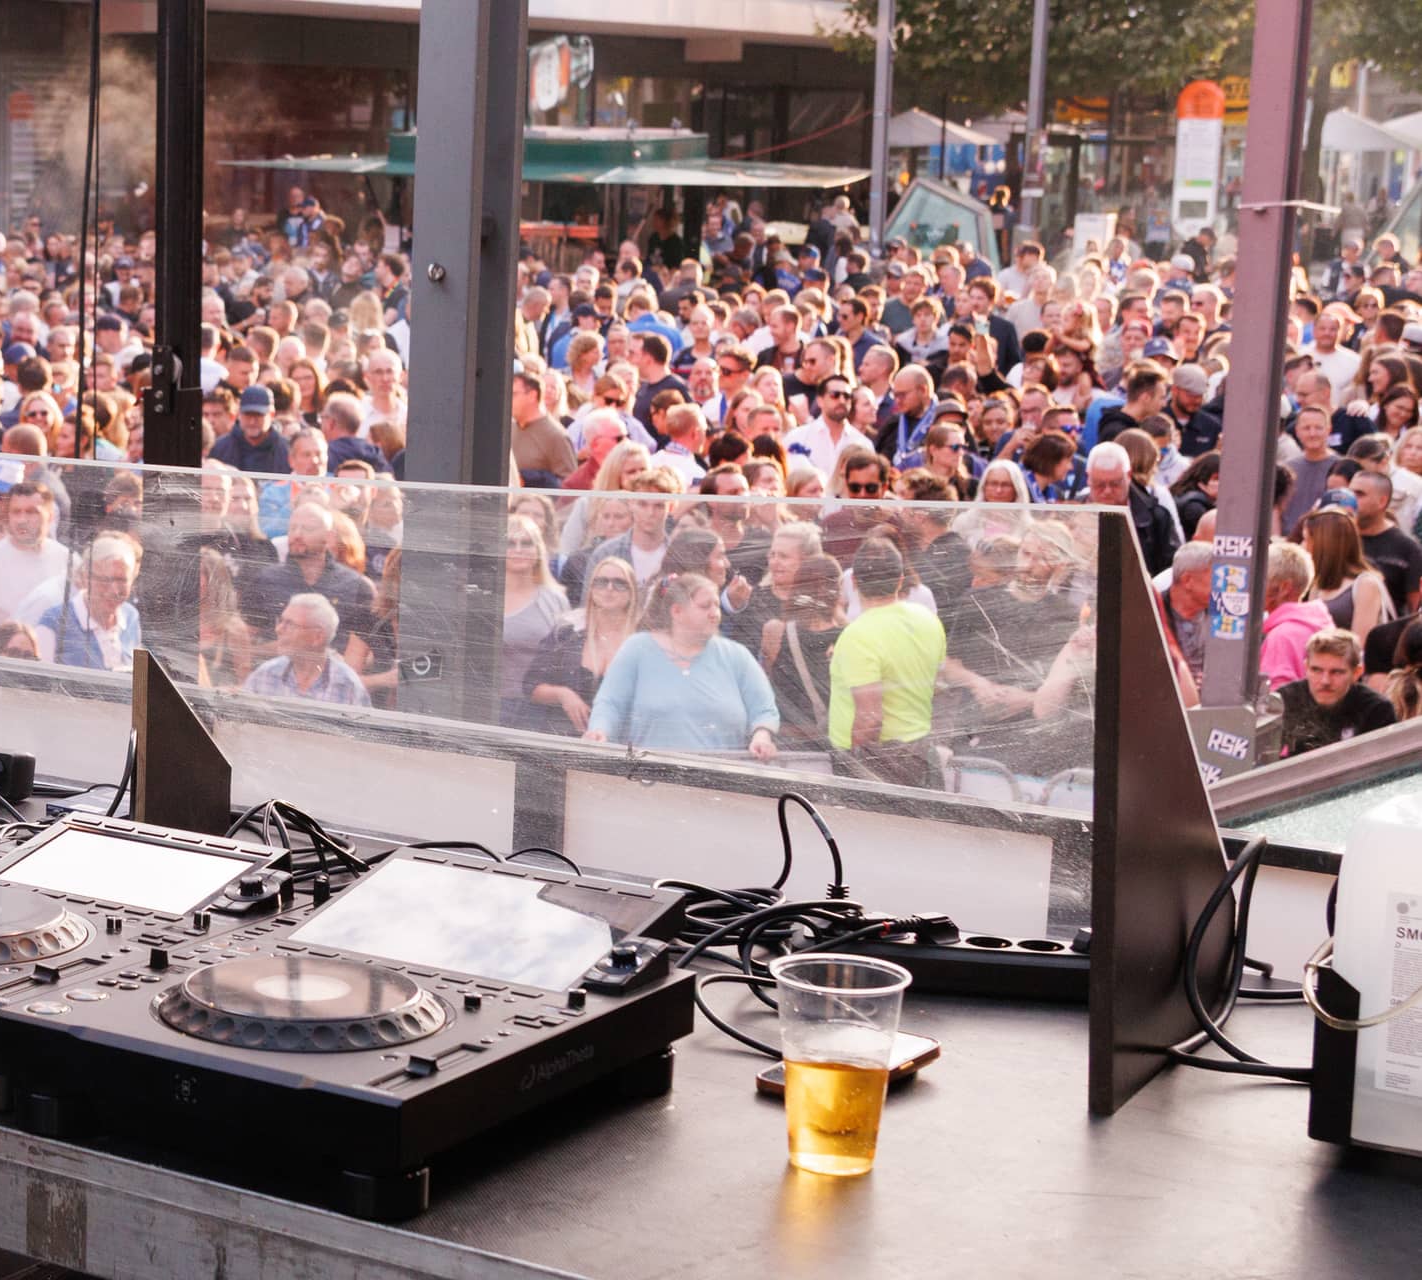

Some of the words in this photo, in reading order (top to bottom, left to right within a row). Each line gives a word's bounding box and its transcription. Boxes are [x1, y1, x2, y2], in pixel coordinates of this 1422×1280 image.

[1213, 535, 1253, 557] RSK
[1207, 728, 1249, 760] RSK
[1395, 926, 1422, 941] SM
